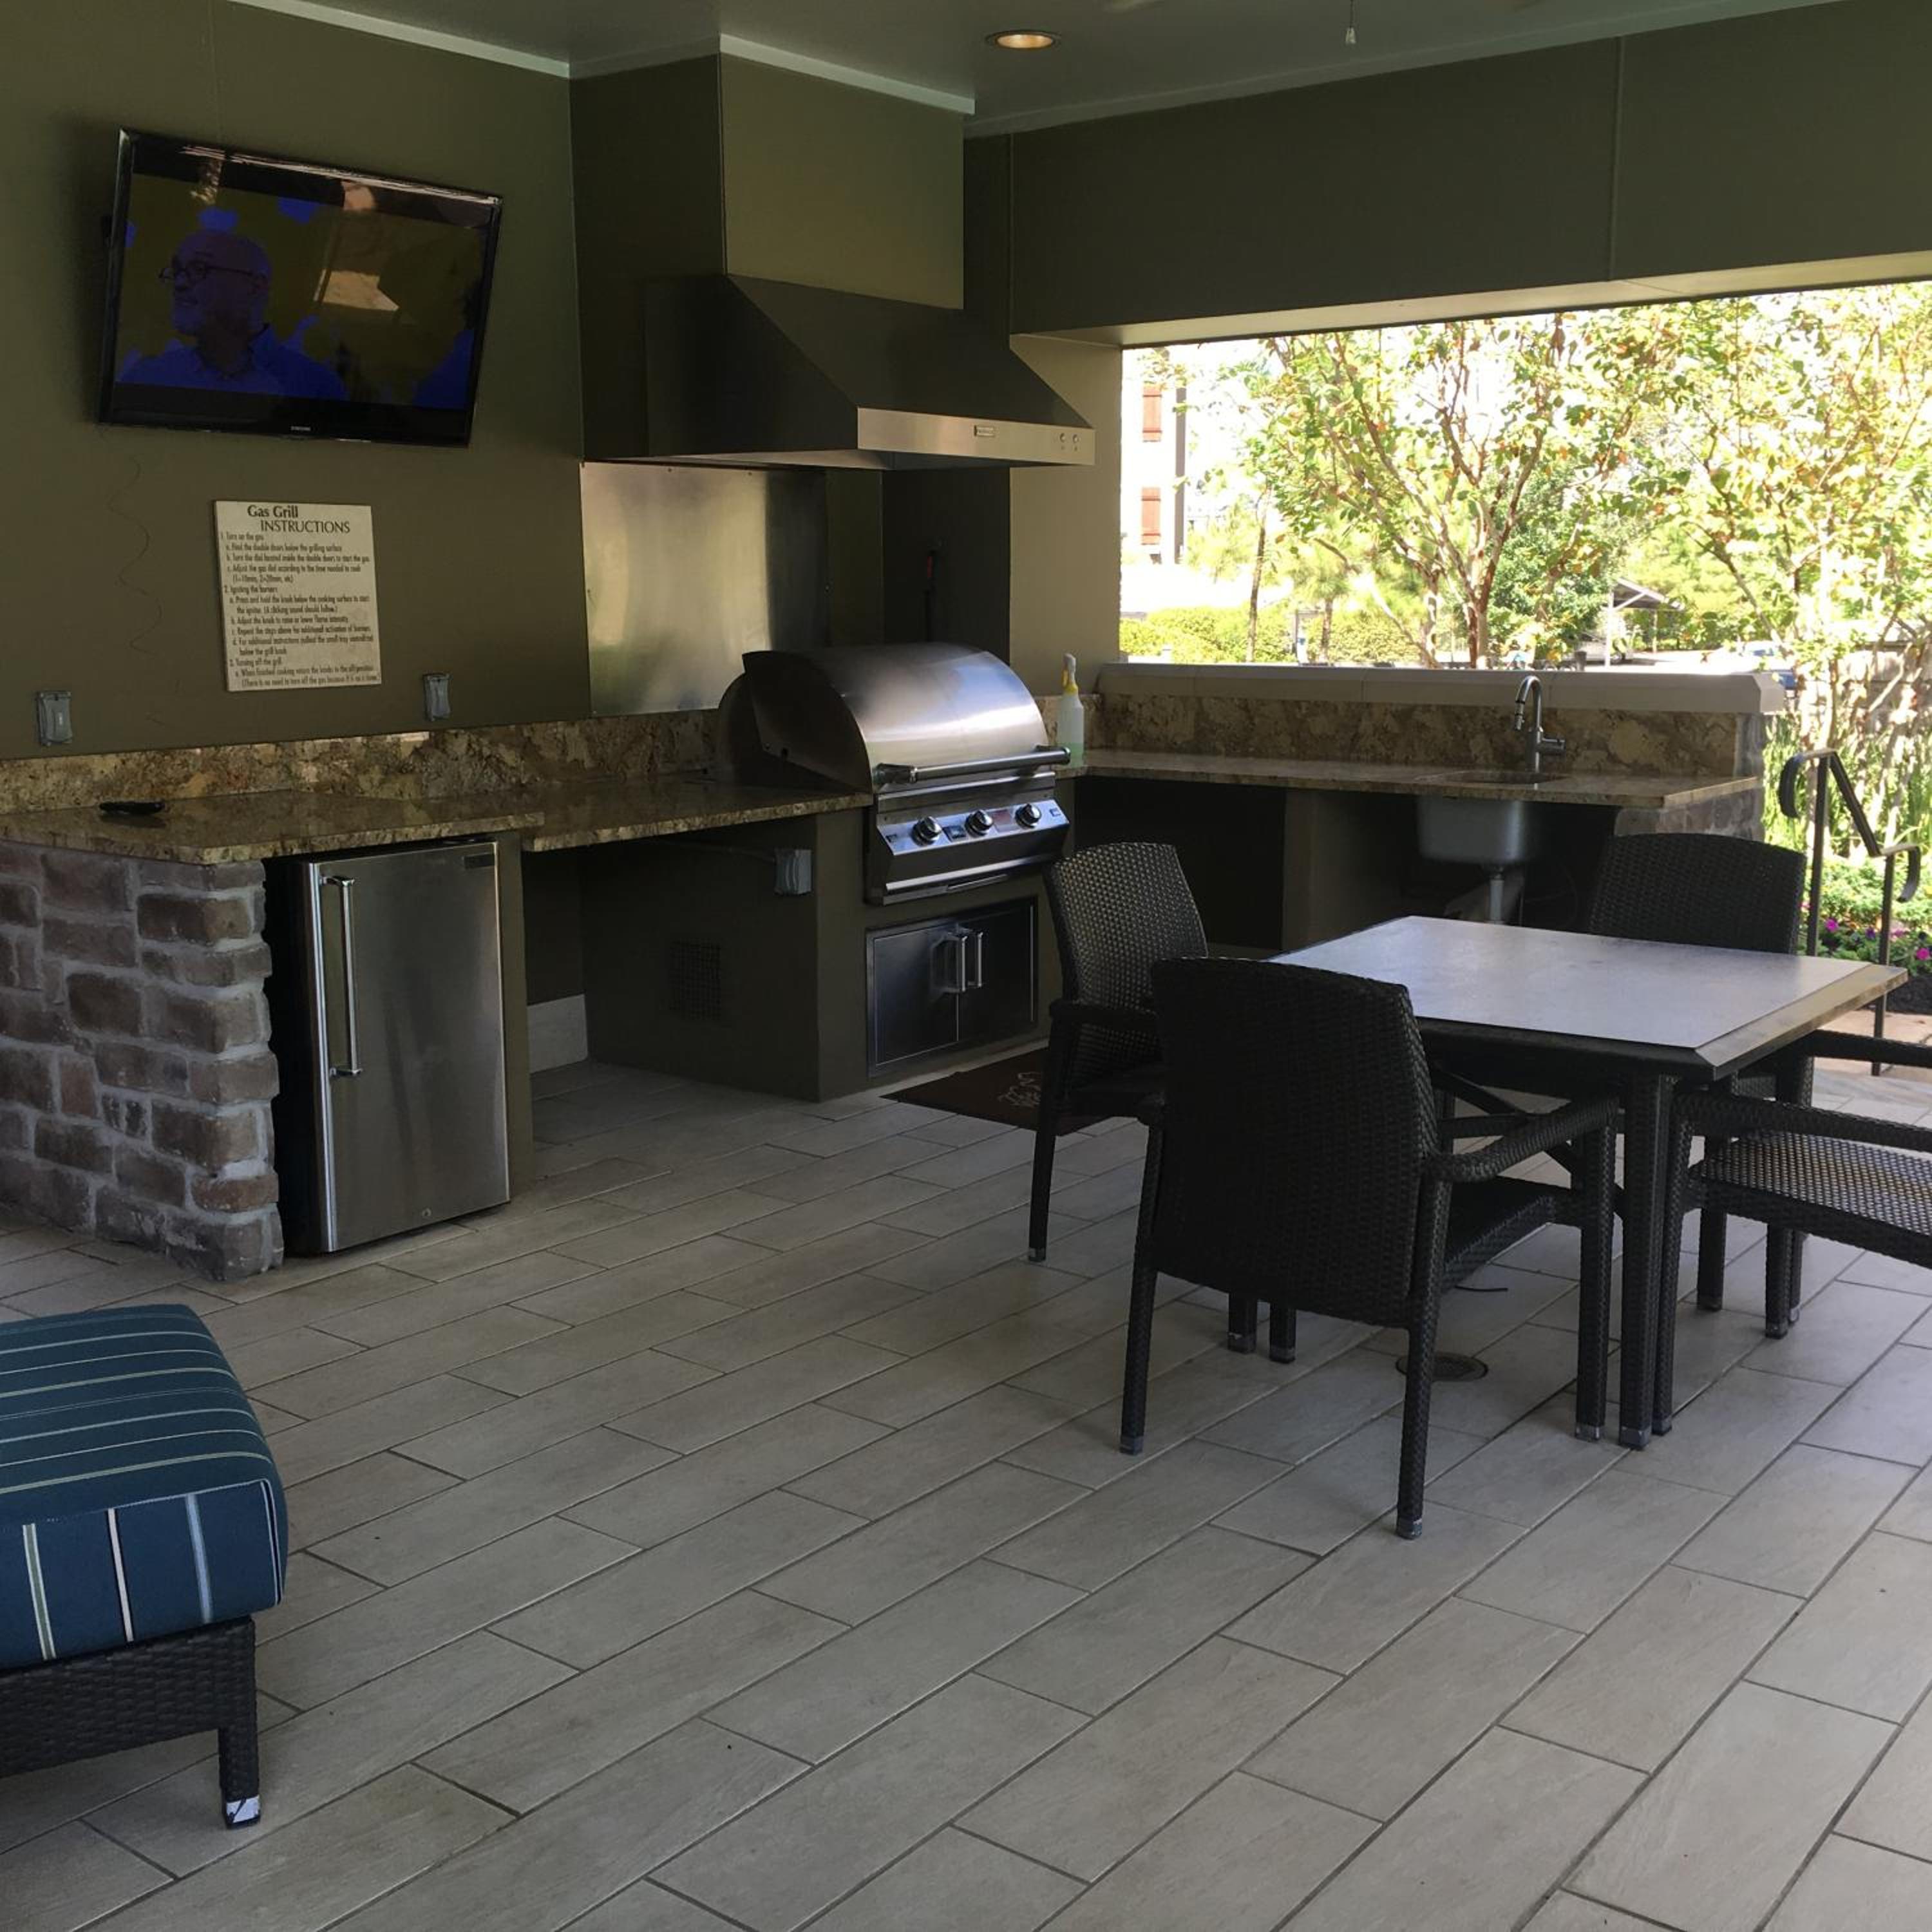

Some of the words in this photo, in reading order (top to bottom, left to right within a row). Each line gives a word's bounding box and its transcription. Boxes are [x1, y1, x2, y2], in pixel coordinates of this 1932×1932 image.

[247, 505, 269, 518] Gas
[273, 506, 299, 518] Grill
[261, 520, 351, 534] INSTRUCTIONS
